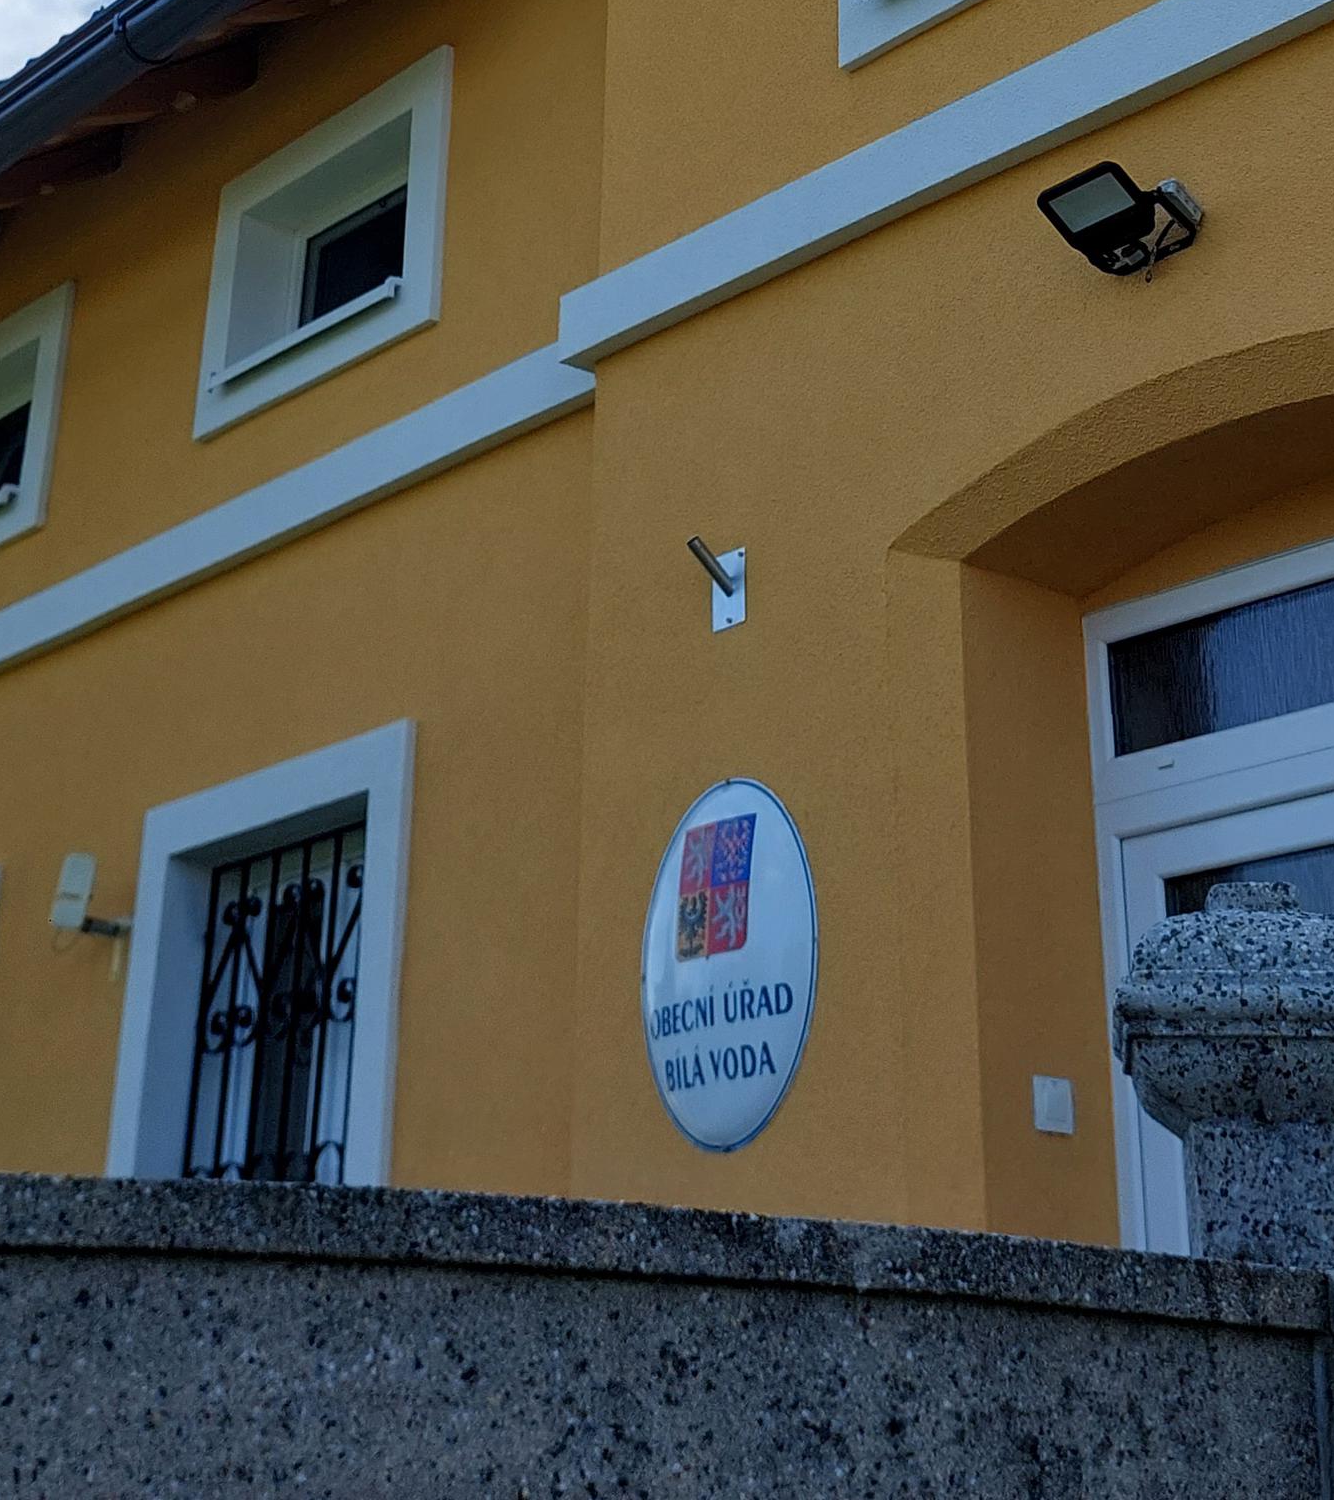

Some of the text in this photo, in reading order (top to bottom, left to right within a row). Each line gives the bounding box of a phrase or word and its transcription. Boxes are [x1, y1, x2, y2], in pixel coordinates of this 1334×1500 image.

[723, 979, 794, 1024] ÚŘAD
[665, 1041, 777, 1092] BÍLÁ VODA
